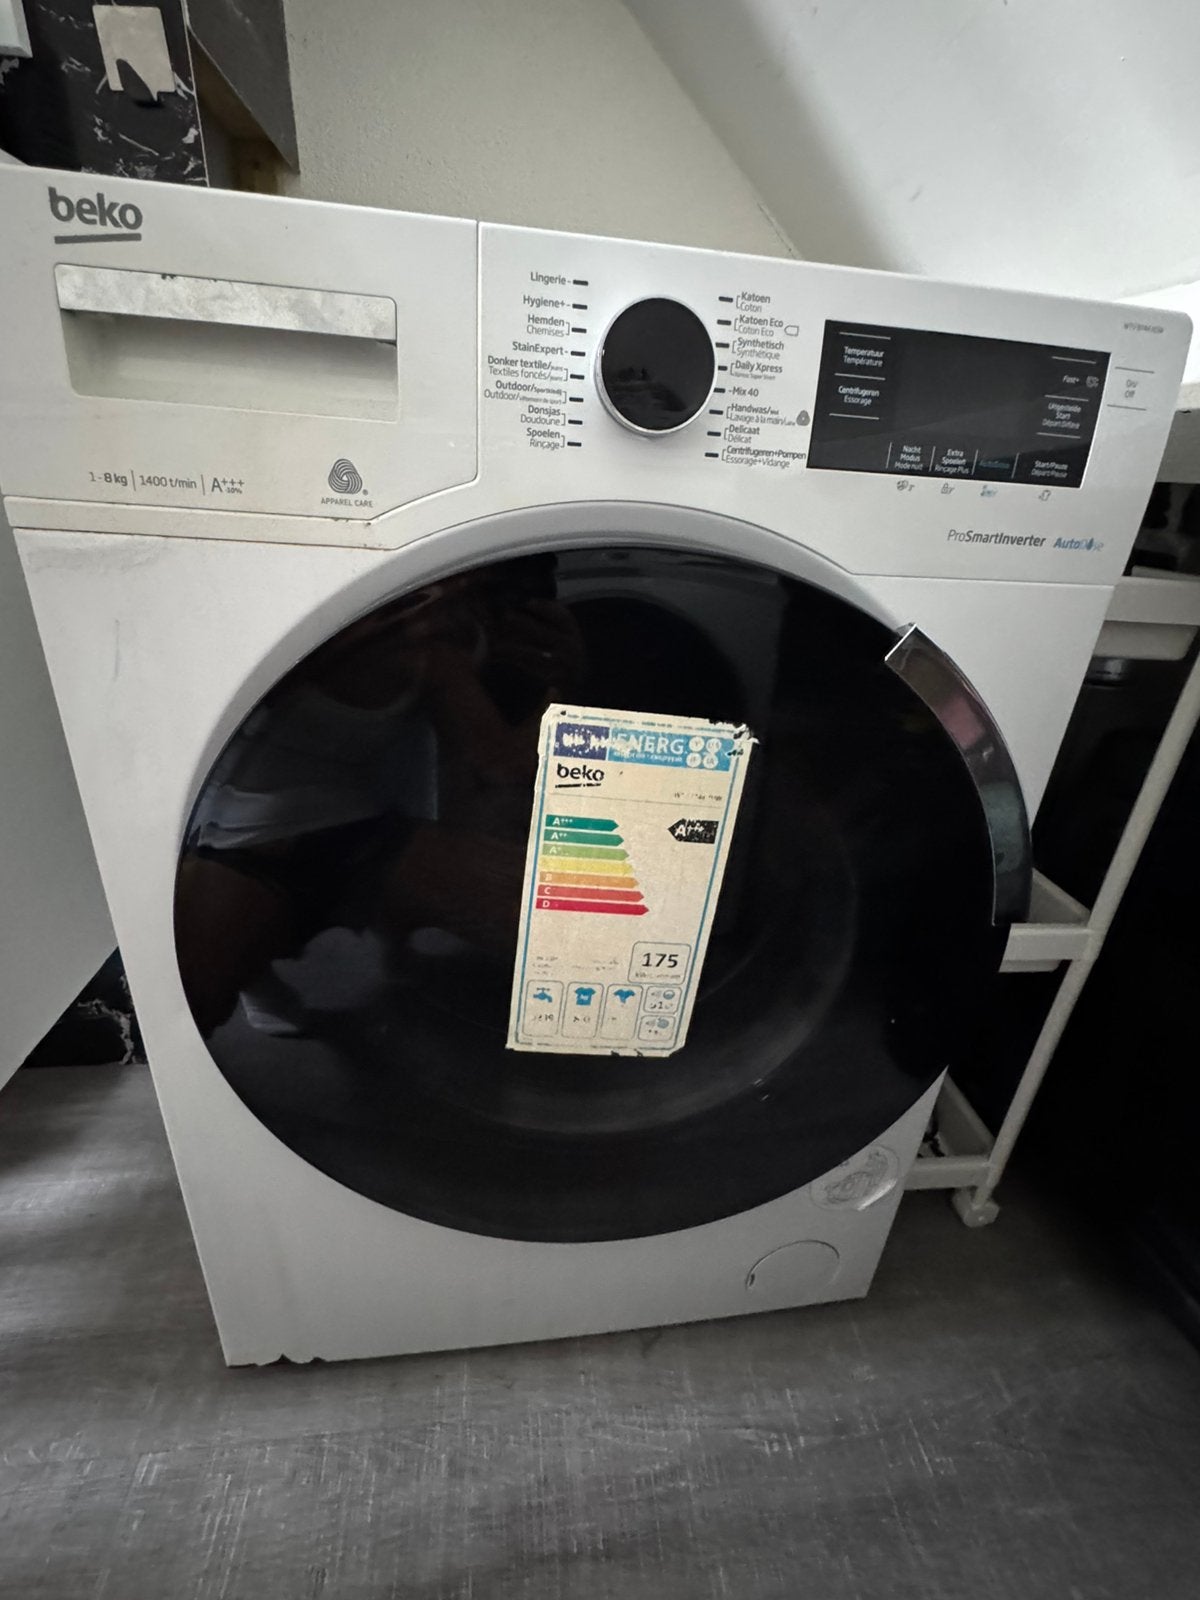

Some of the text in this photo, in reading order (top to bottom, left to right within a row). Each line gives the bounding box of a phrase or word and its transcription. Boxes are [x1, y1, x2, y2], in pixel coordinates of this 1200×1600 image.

[48, 186, 143, 230] beko
[530, 271, 566, 285] Lingerie
[523, 294, 565, 308] Hygiene+
[741, 291, 770, 303] Katoen
[740, 301, 762, 312] Coton
[528, 313, 564, 327] Hemden
[739, 314, 784, 328] Katoen Eco
[526, 324, 565, 337] Chemises
[738, 325, 775, 337] Coton Eco
[512, 341, 564, 356] StainExpert
[737, 337, 784, 351] Synthetisch
[488, 355, 519, 367] Donker
[735, 360, 783, 374] Daily Xpress
[489, 365, 520, 378] Textiles
[732, 386, 759, 397] Mix 40
[528, 404, 561, 417] Donsjas
[520, 414, 561, 426] Doudoune
[730, 413, 755, 424] Lavage
[526, 427, 561, 439] Spoelen
[728, 424, 760, 435] Delicaat
[529, 438, 560, 451] Rinçage
[902, 445, 921, 454] Nacht
[726, 445, 807, 460] Centrifugeren+Pompen
[900, 454, 920, 462] Modus
[946, 448, 964, 457] Extra
[138, 474, 197, 489] 1400 t/min
[211, 477, 245, 493] A+++
[321, 497, 374, 508] APPAREL CARE
[947, 529, 1046, 547] ProSmartInverter
[616, 733, 685, 756] ENERG
[557, 763, 605, 782] beko
[544, 886, 552, 895] C
[542, 900, 550, 908] D
[641, 952, 680, 969] 175
